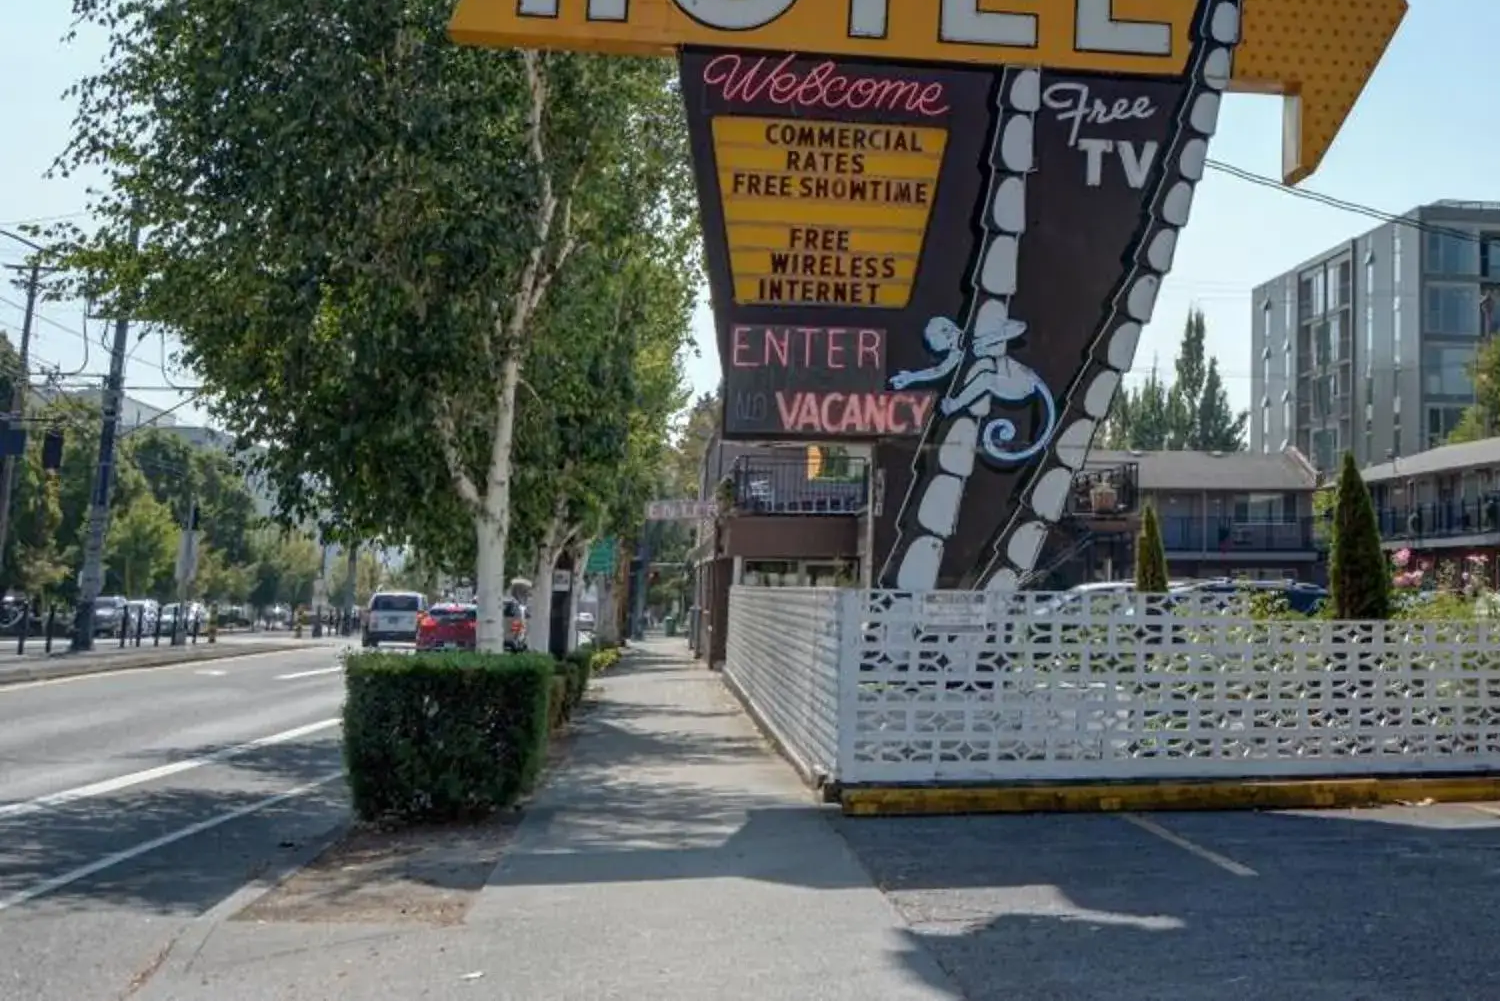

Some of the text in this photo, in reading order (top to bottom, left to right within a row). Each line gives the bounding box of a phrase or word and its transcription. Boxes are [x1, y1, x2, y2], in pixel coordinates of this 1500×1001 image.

[704, 53, 949, 115] Welcome
[1042, 82, 1158, 146] Free
[765, 123, 923, 152] COMMERCIAL
[786, 151, 865, 174] RATES
[1078, 138, 1158, 188] TV
[732, 173, 927, 204] FREE SHOWTIME
[790, 228, 849, 251] FREE
[771, 252, 896, 279] WIRELESS
[758, 278, 881, 304] INTERNET
[732, 327, 881, 370] ENTER
[775, 390, 931, 433] VACANCY
